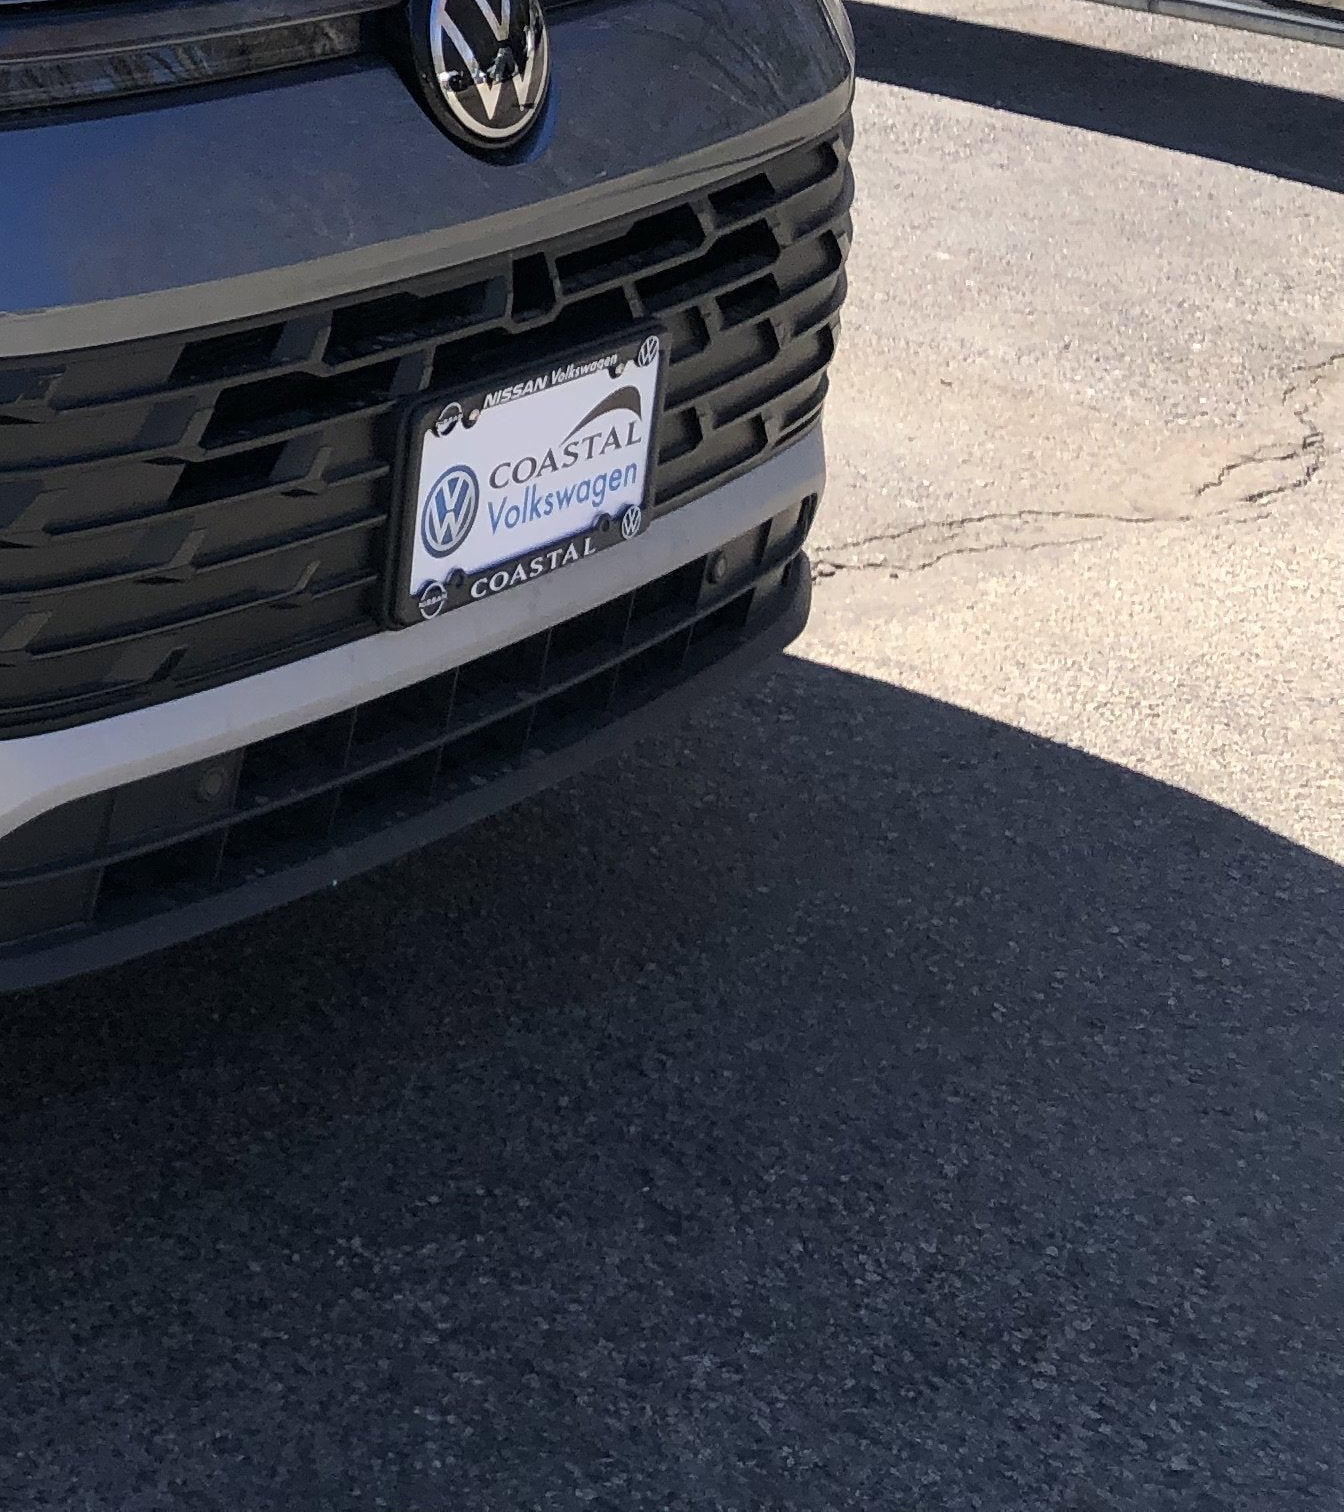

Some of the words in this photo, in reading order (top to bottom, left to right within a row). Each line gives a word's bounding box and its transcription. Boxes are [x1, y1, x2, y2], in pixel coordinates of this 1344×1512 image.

[483, 374, 548, 409] NISSAN
[551, 353, 619, 385] Volkswagen
[489, 420, 643, 489] COASTAL
[487, 461, 638, 535] Volkswagen
[470, 537, 597, 599] COASTAL
